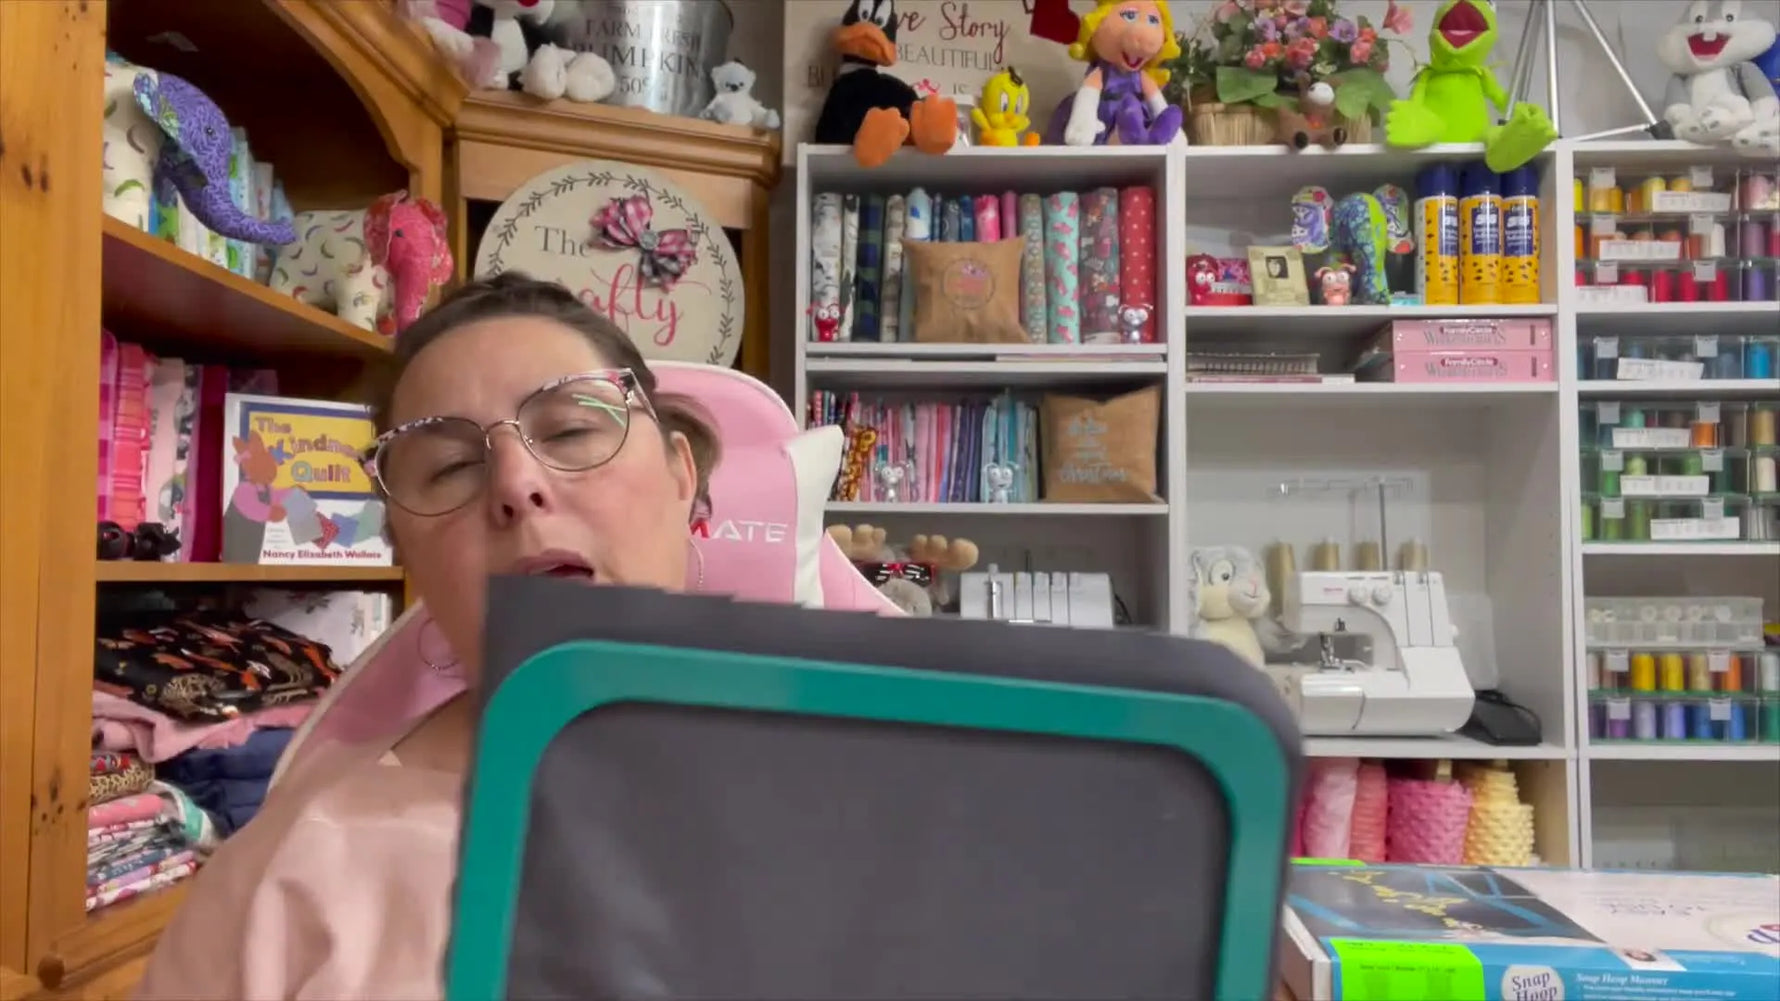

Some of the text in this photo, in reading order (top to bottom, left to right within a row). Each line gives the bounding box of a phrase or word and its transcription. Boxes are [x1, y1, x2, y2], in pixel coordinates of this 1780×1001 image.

[585, 19, 641, 39] FARM
[897, 1, 1009, 64] ve Story
[534, 225, 590, 258] The
[579, 263, 711, 346] afty
[254, 416, 292, 434] The
[291, 461, 351, 483] Quilt
[263, 549, 382, 560] Nancy Elizabeth Wallace
[1512, 972, 1550, 992] Snap
